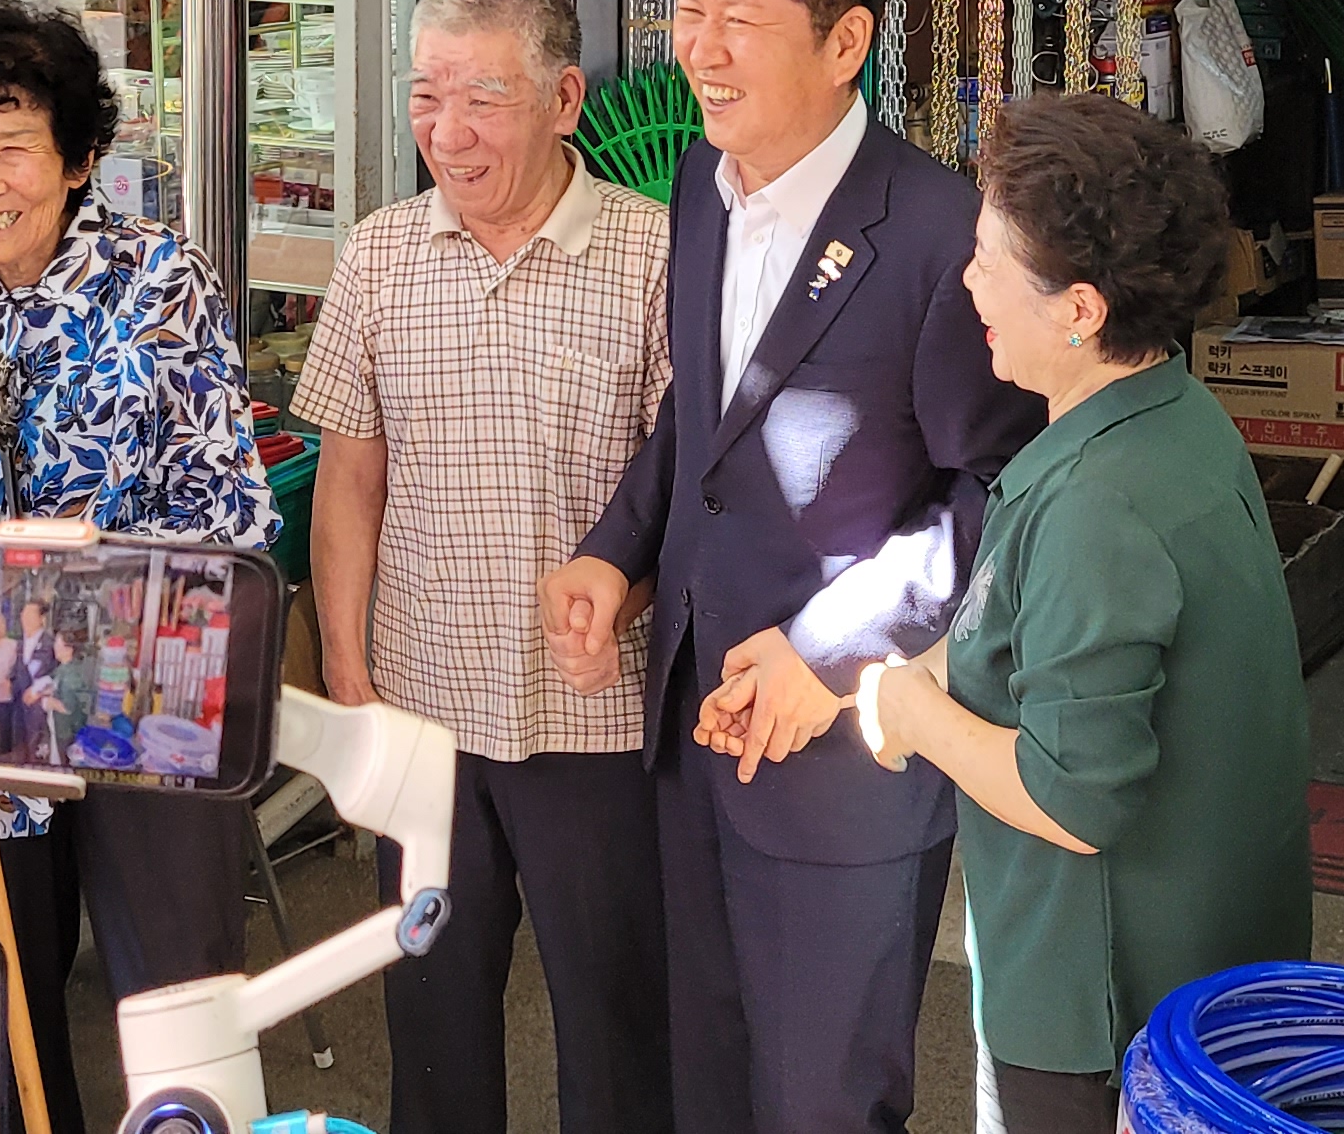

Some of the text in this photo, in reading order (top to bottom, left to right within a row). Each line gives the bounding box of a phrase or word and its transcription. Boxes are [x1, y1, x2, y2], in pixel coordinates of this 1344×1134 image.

[1208, 345, 1232, 359] 럭키
[1208, 362, 1288, 379] 락카 스프레이
[1261, 409, 1321, 419] COLOR SPRAY
[1260, 434, 1336, 448] INDUSTRIAL
